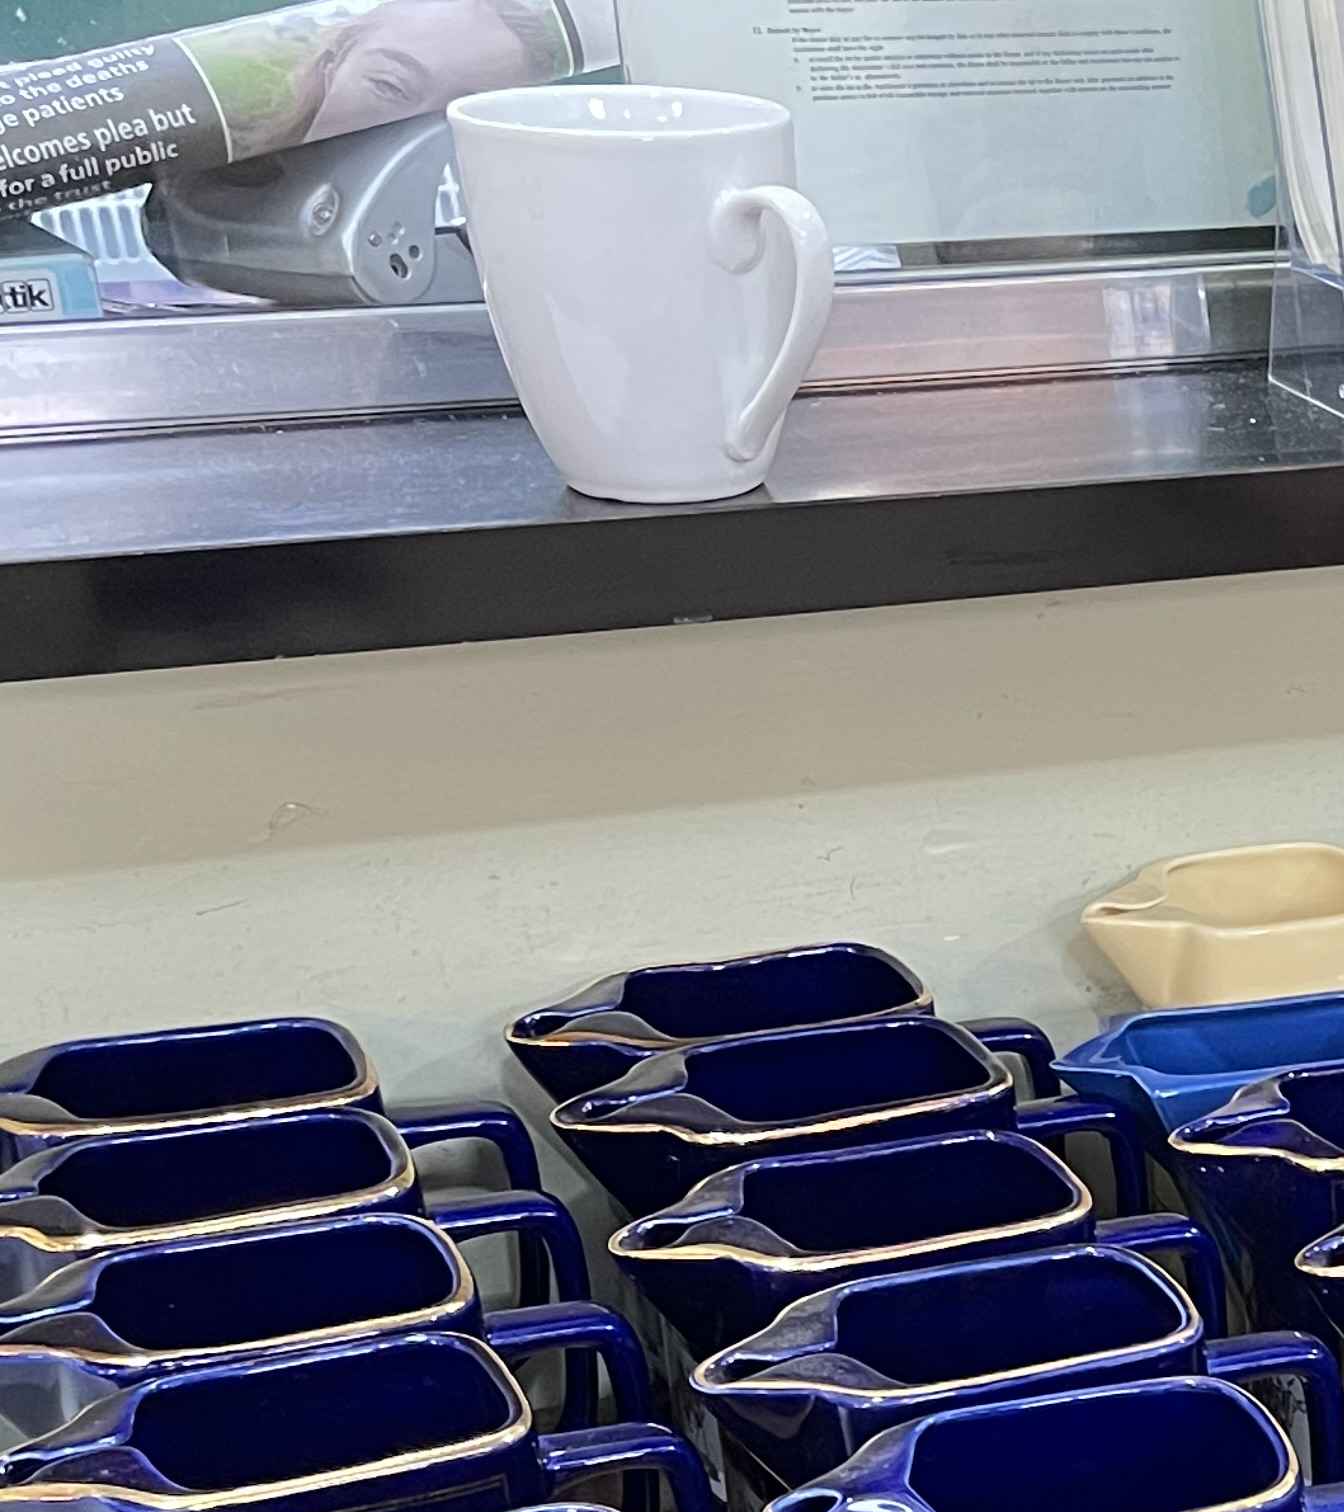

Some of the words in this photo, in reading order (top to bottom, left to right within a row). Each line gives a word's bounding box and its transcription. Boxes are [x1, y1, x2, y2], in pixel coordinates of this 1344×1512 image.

[19, 83, 62, 101] the
[65, 59, 149, 88] deaths
[22, 86, 125, 128] patients
[93, 117, 149, 152] plea
[148, 103, 197, 134] but
[0, 176, 36, 199] for
[40, 173, 56, 188] a
[59, 156, 101, 184] full
[104, 141, 179, 178] public
